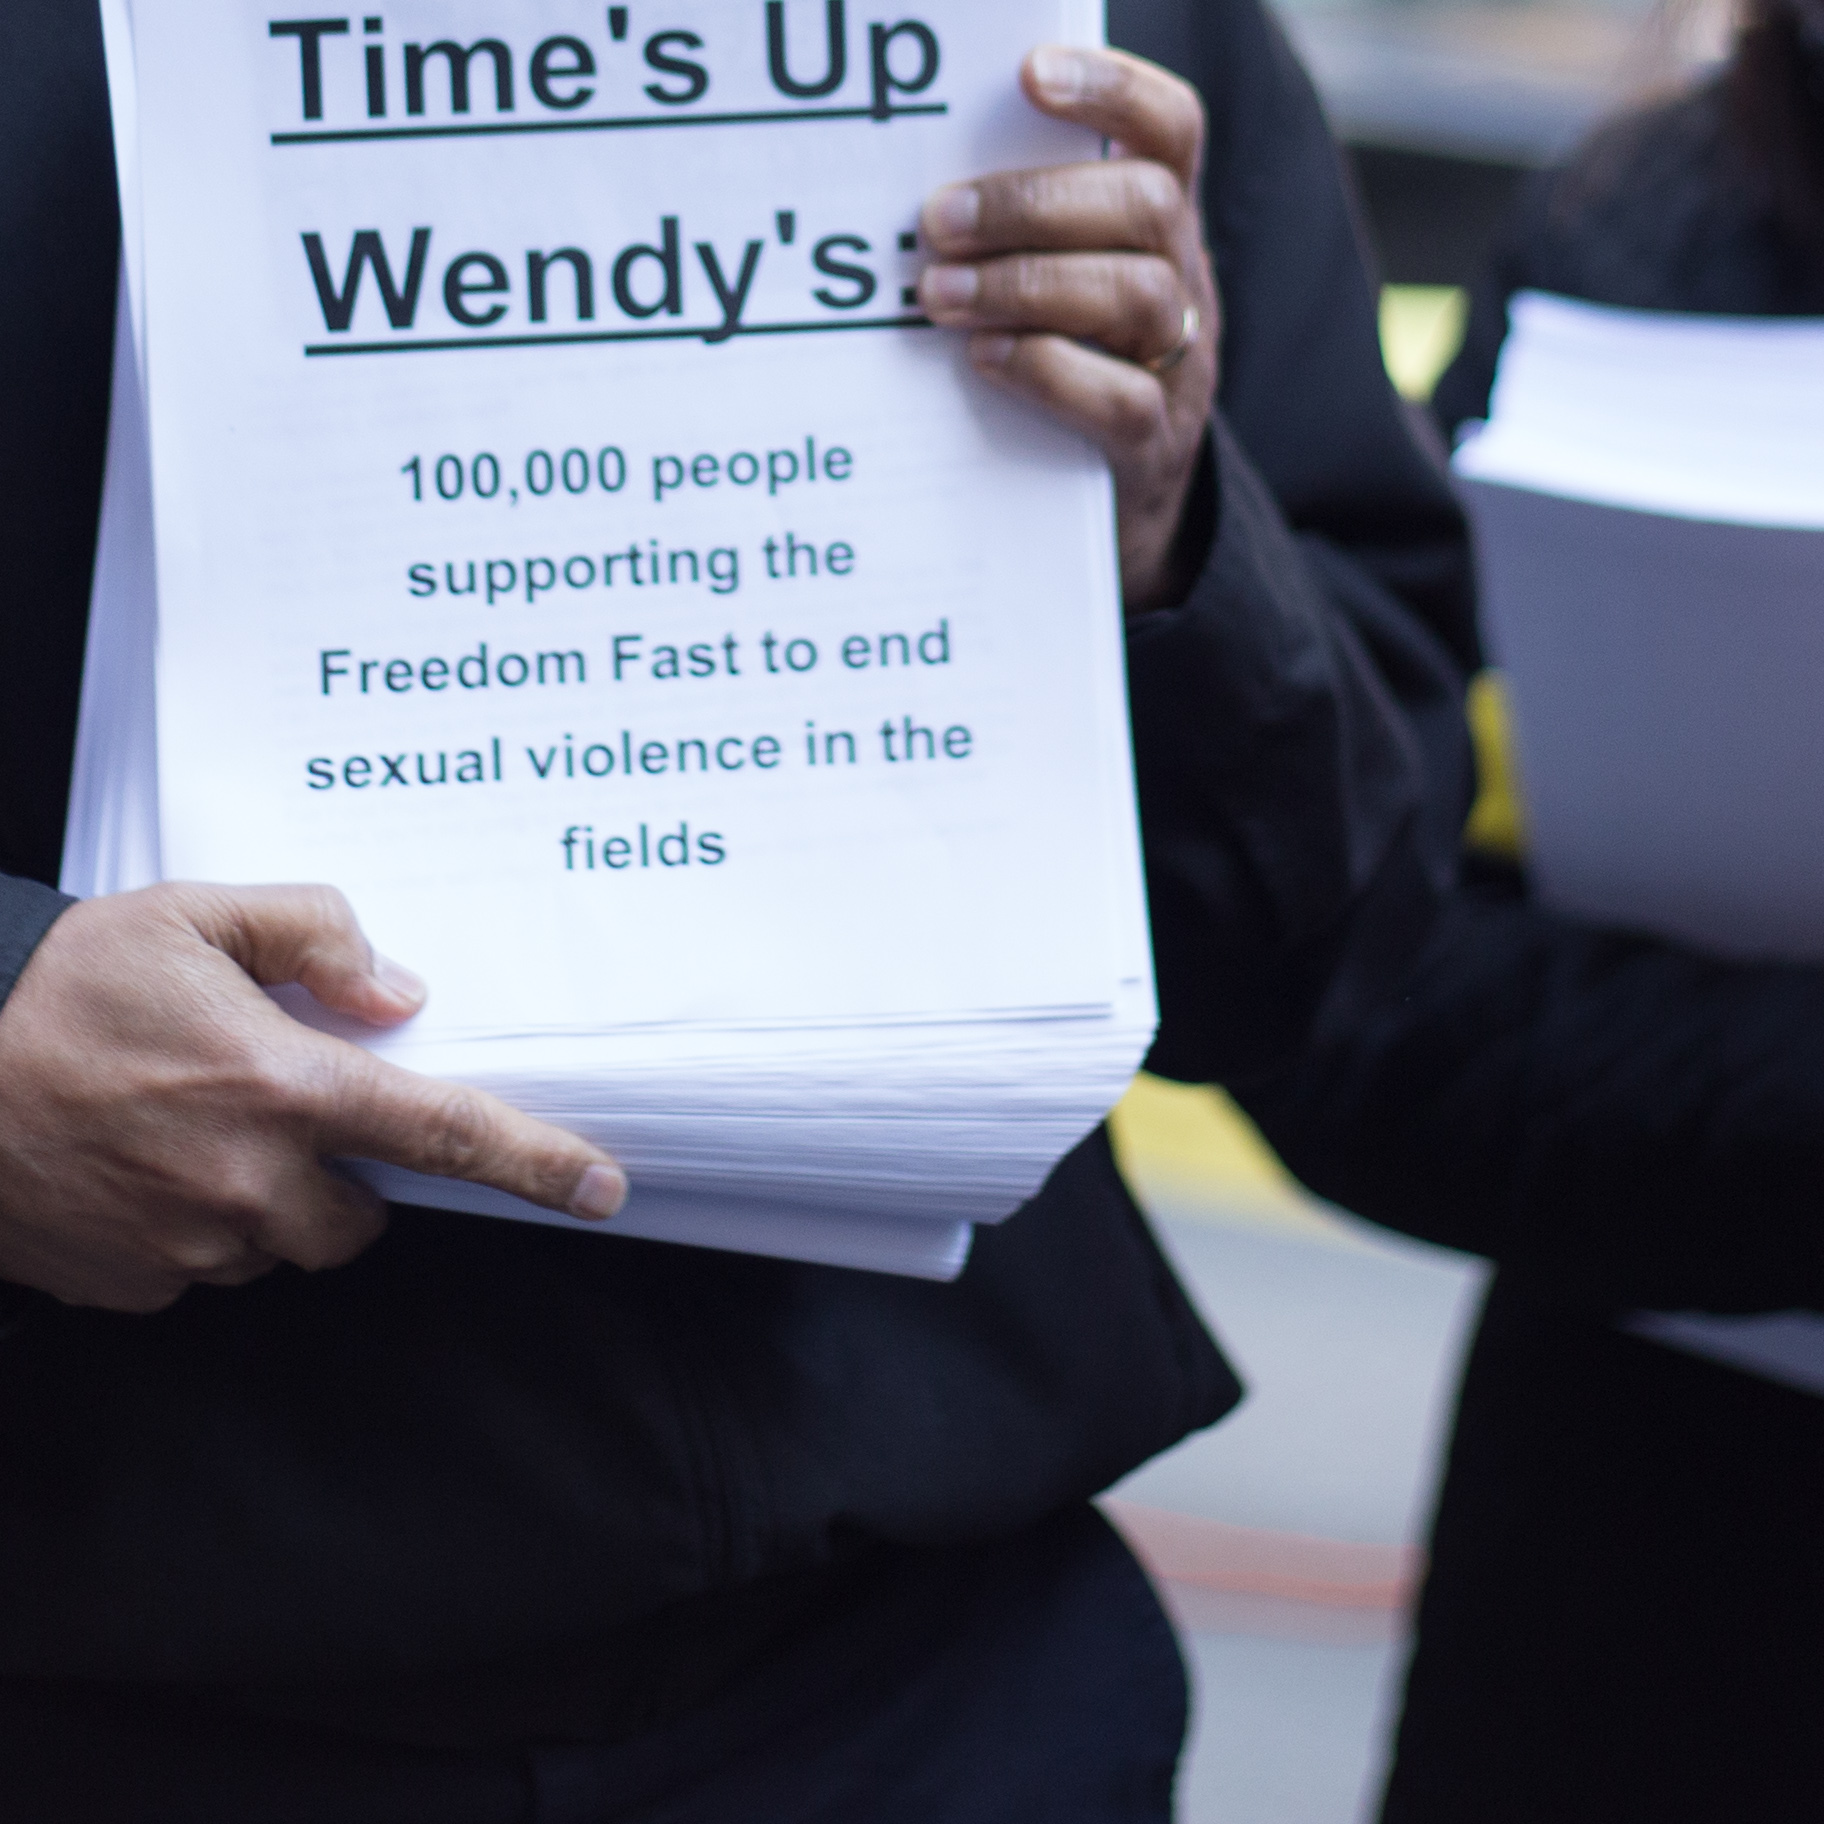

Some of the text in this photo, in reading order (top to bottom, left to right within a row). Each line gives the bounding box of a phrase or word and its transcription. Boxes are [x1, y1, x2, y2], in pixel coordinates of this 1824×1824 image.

[267, 5, 711, 122] Time's
[401, 436, 853, 506] 100,000 people
[407, 532, 855, 606] supporting the
[320, 620, 950, 696] Freedom Fast to end
[306, 716, 973, 790] sexual violence in the
[560, 821, 727, 871] fields
